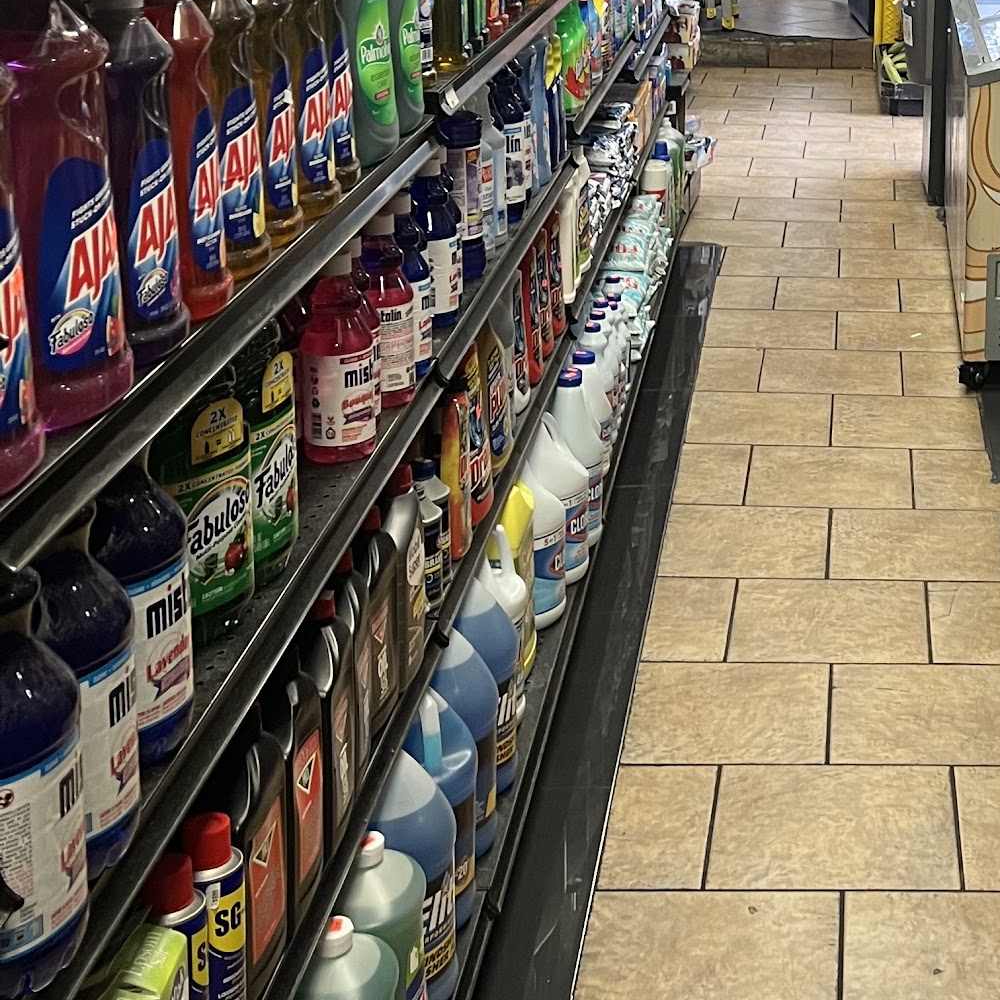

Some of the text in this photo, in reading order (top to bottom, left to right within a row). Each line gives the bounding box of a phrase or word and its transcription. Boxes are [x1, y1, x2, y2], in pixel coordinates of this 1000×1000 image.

[380, 309, 402, 323] tolin
[48, 313, 94, 355] Fabuloso
[274, 360, 284, 375] 2X
[210, 407, 226, 425] 2X
[196, 415, 238, 439] CONCENTRATED
[256, 431, 266, 441] 2X
[177, 481, 192, 494] 2X
